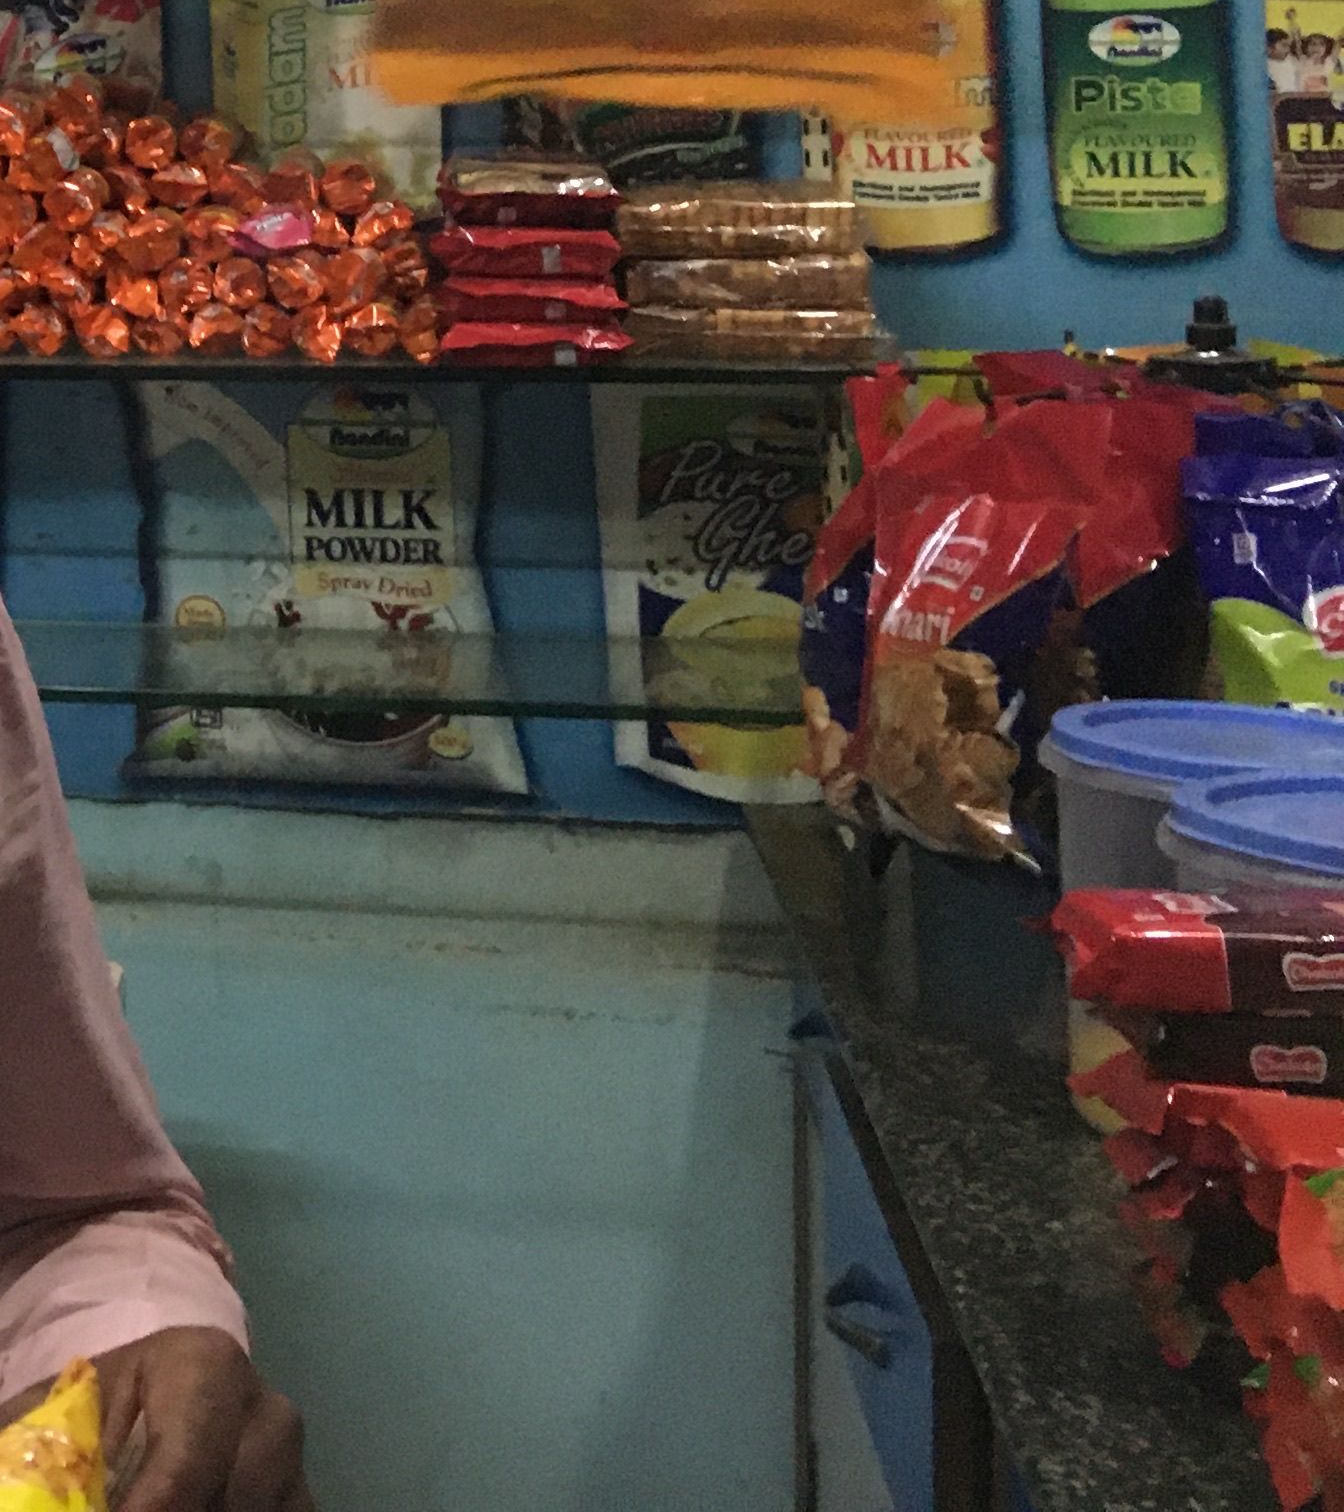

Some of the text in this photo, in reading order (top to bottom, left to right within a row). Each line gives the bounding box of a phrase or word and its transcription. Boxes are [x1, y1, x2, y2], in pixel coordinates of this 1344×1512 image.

[866, 143, 971, 173] MILK
[1085, 150, 1198, 179] MILK
[659, 438, 800, 503] Pure
[304, 487, 442, 531] MILK
[303, 535, 444, 565] POWDER
[696, 493, 815, 589] Ghe
